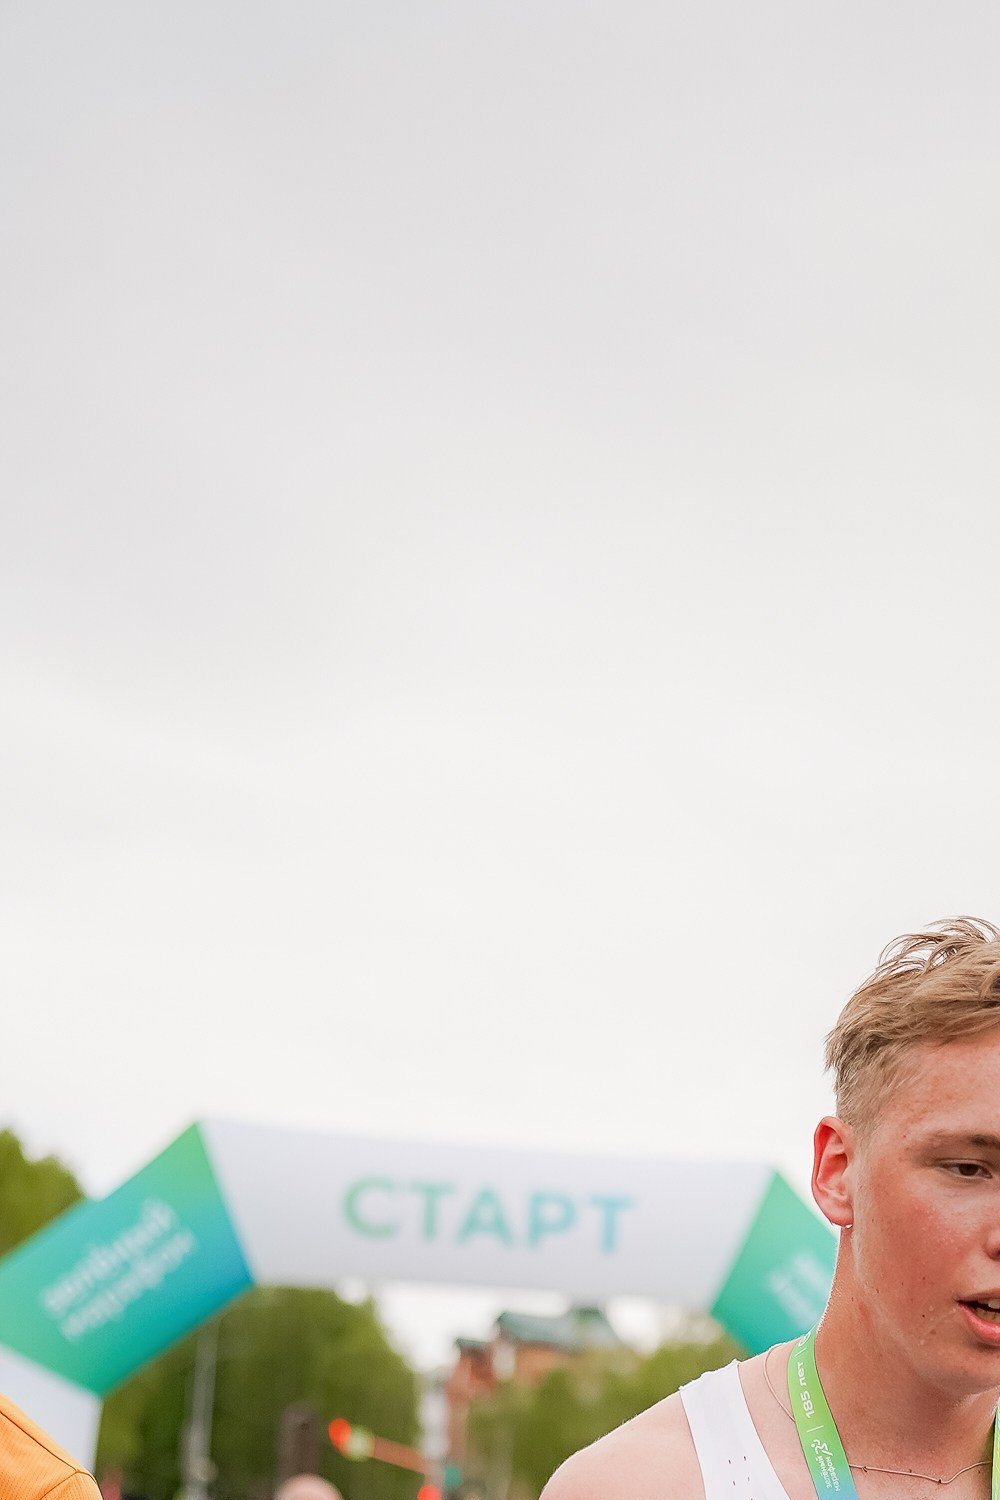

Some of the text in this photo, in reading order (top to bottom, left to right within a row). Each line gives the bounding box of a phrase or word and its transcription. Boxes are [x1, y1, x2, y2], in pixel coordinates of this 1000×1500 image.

[343, 1175, 634, 1256] СТАРТ
[797, 1361, 815, 1419] 185 лет
